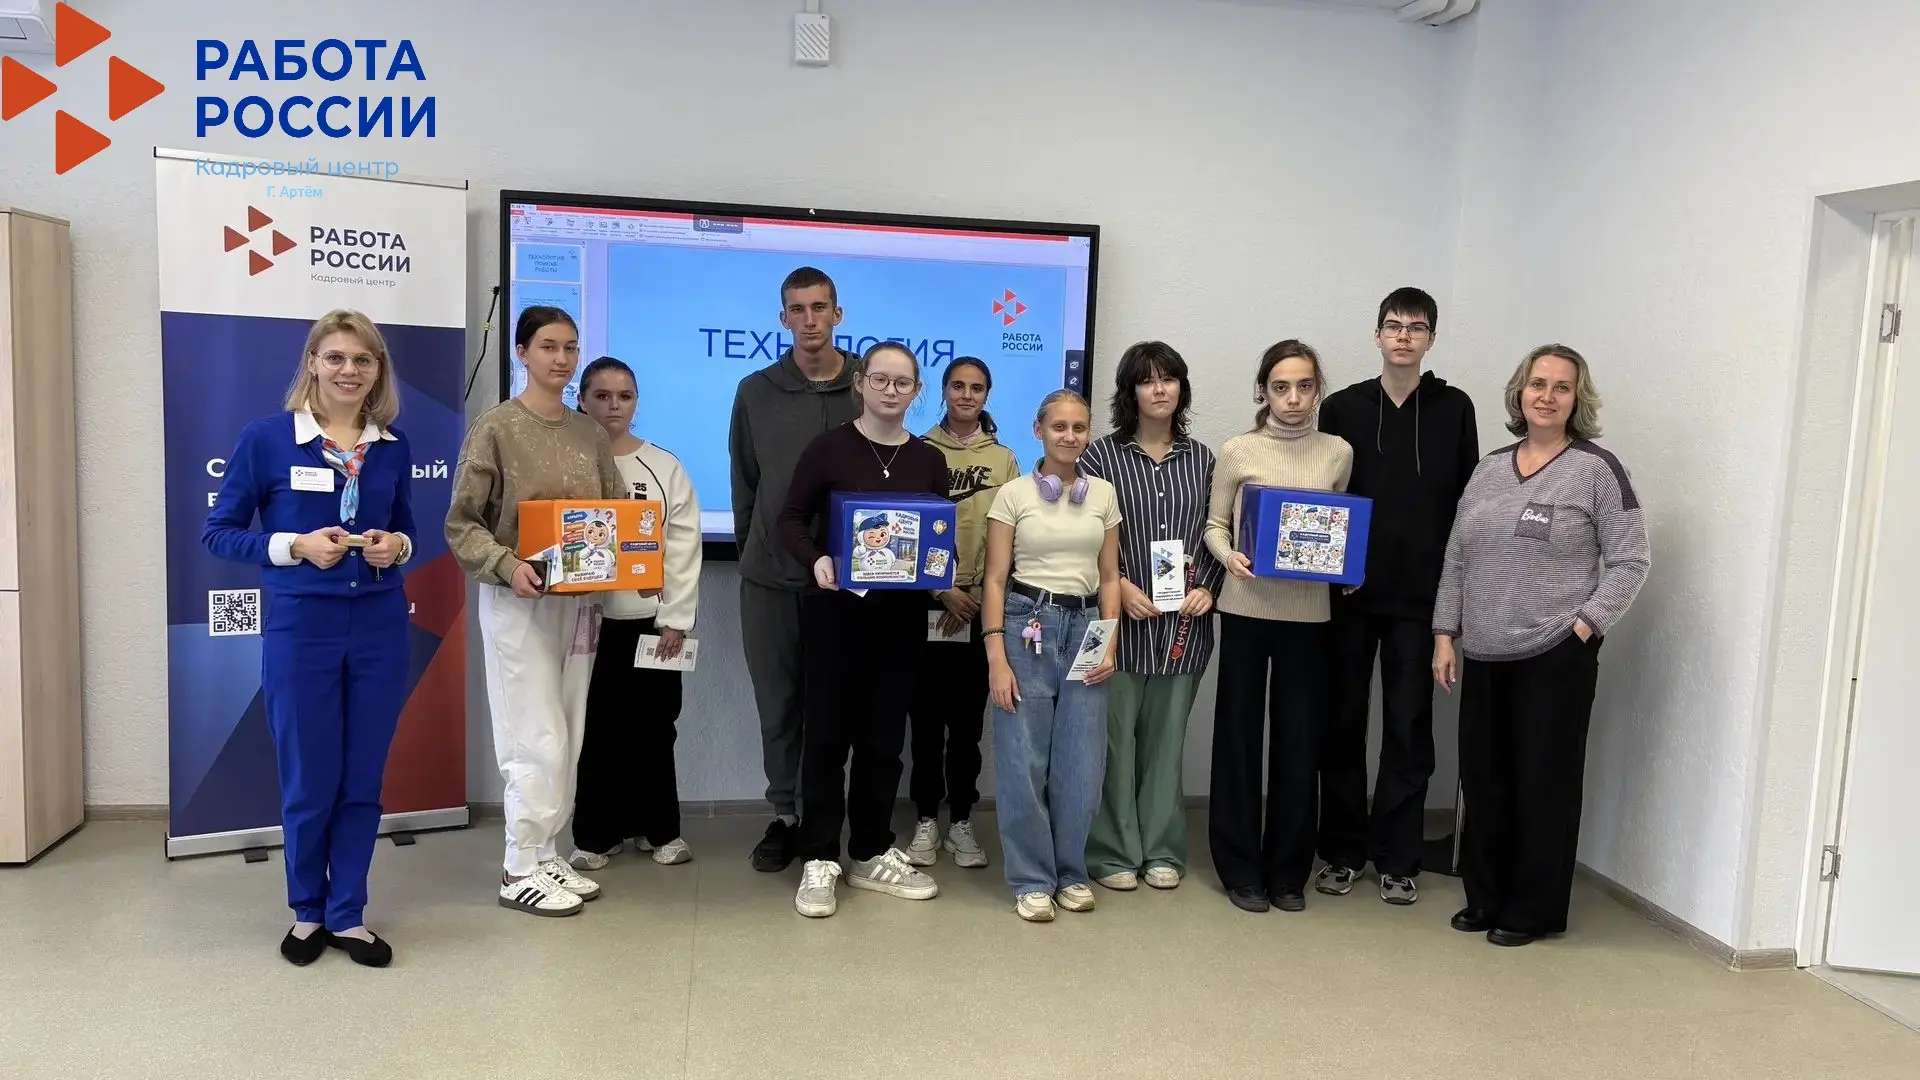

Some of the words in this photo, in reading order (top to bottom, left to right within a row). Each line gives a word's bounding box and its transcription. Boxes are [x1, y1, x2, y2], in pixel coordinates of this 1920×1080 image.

[310, 226, 407, 251] РАБОТА
[310, 249, 411, 273] РОССИИ
[310, 273, 364, 286] Кадровый
[365, 279, 397, 288] центр
[1002, 332, 1042, 342] РАБОТА
[1002, 342, 1043, 351] РОССИИ
